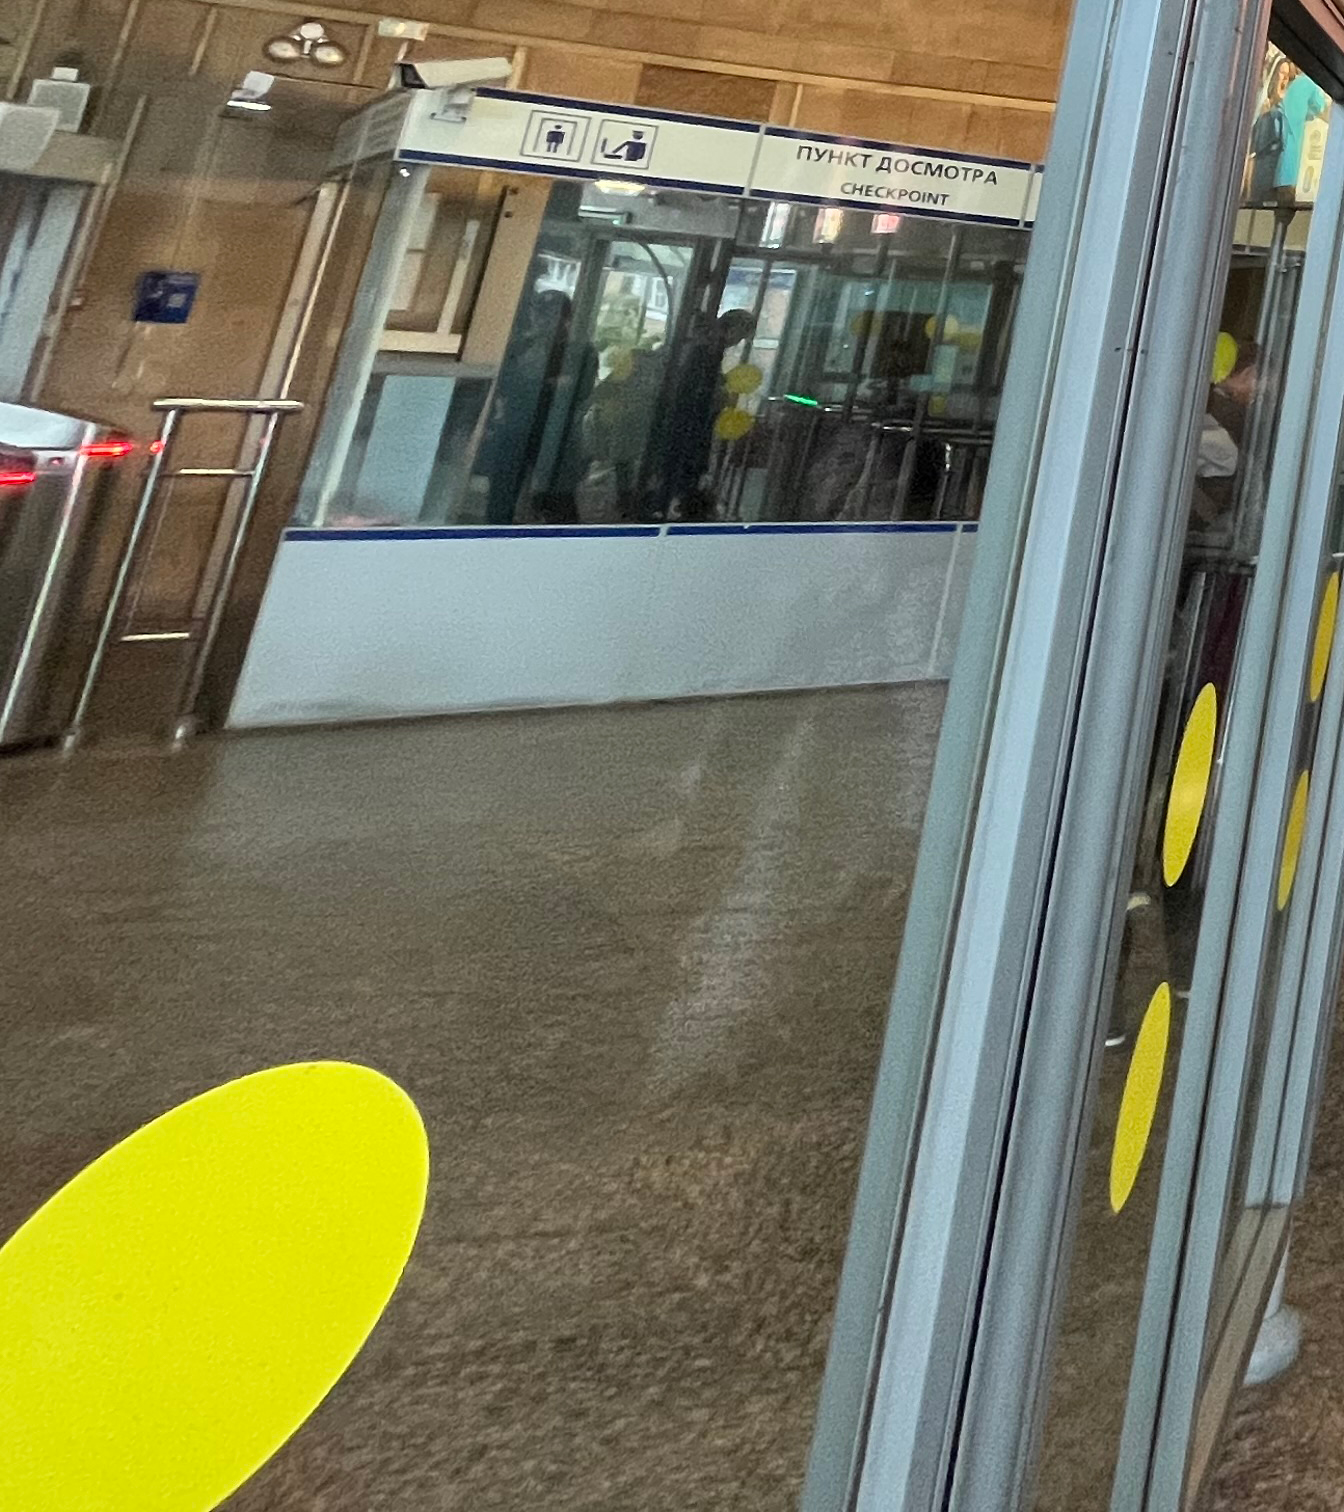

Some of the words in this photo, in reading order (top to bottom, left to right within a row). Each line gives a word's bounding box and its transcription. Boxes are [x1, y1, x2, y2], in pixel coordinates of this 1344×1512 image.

[797, 145, 872, 169] ПУНКТ
[875, 156, 998, 186] ДОСМОТРА
[840, 182, 950, 206] CHECKPOINT
